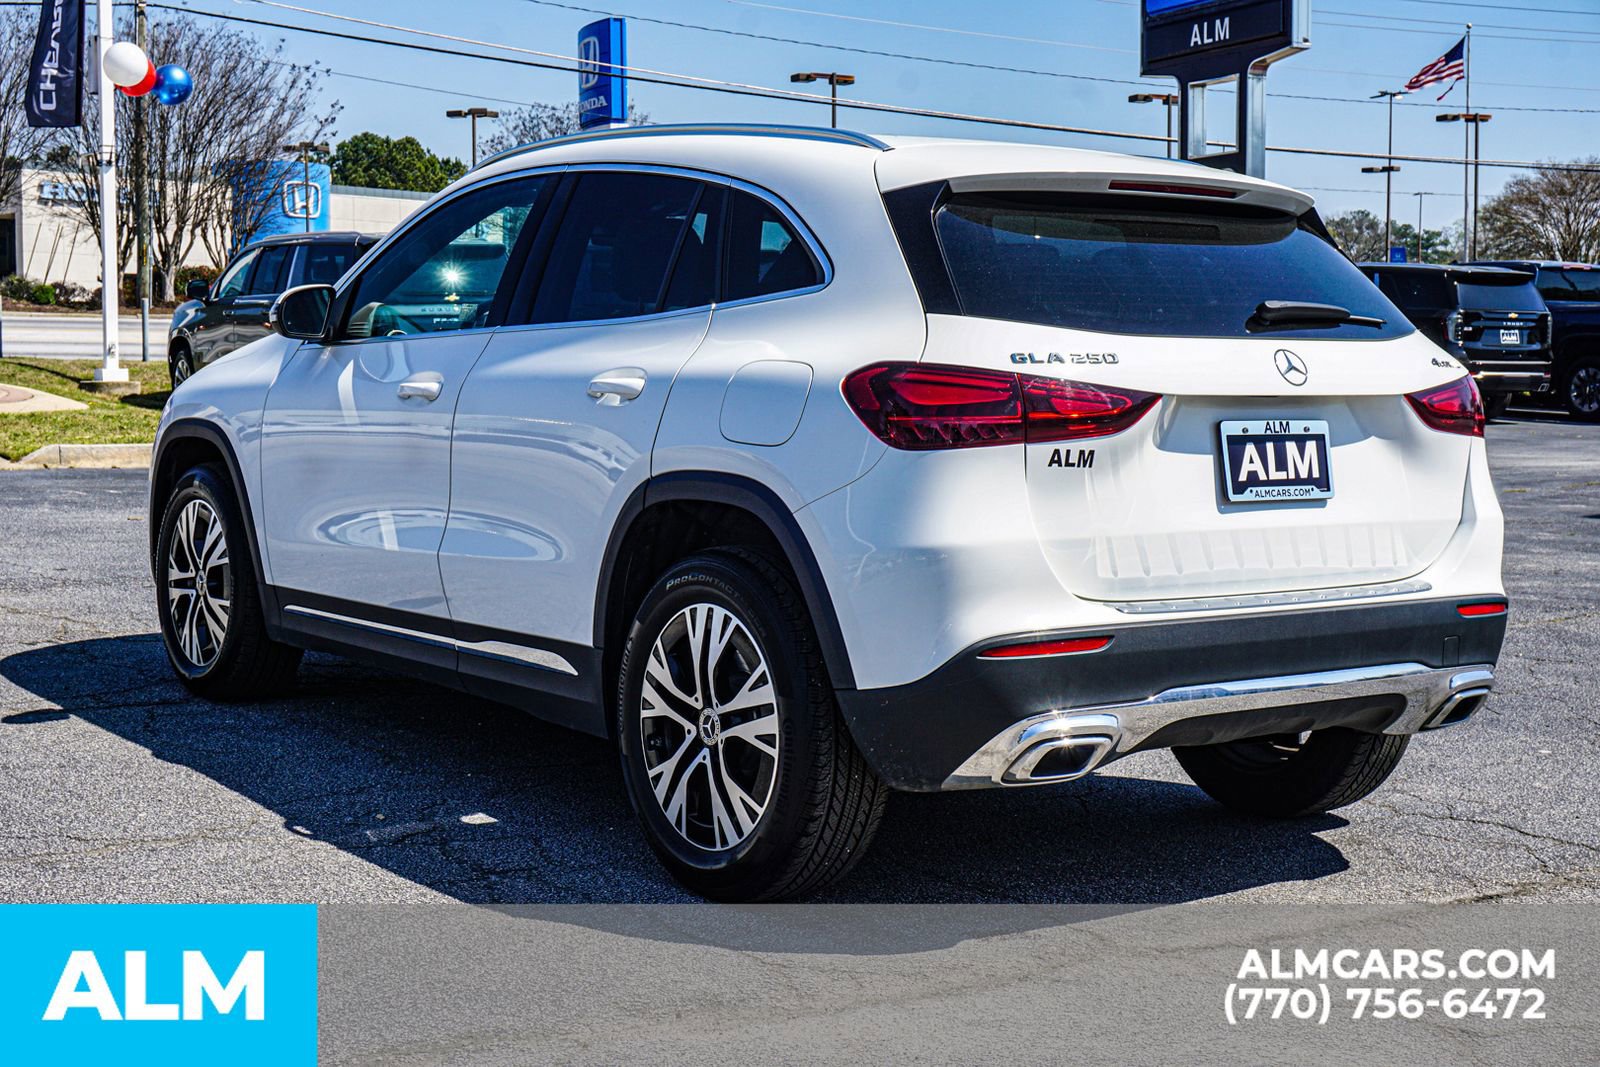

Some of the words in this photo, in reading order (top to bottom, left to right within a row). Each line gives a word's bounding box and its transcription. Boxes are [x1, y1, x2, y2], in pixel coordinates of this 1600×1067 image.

[1189, 17, 1230, 47] ALM
[579, 96, 608, 113] ONDA
[1010, 352, 1066, 364] GLA
[1070, 352, 1120, 364] 250
[1264, 421, 1290, 434] ALM
[1047, 448, 1095, 468] ALM
[1238, 440, 1320, 482] ALM
[1254, 488, 1312, 498] ALMCARS.COM
